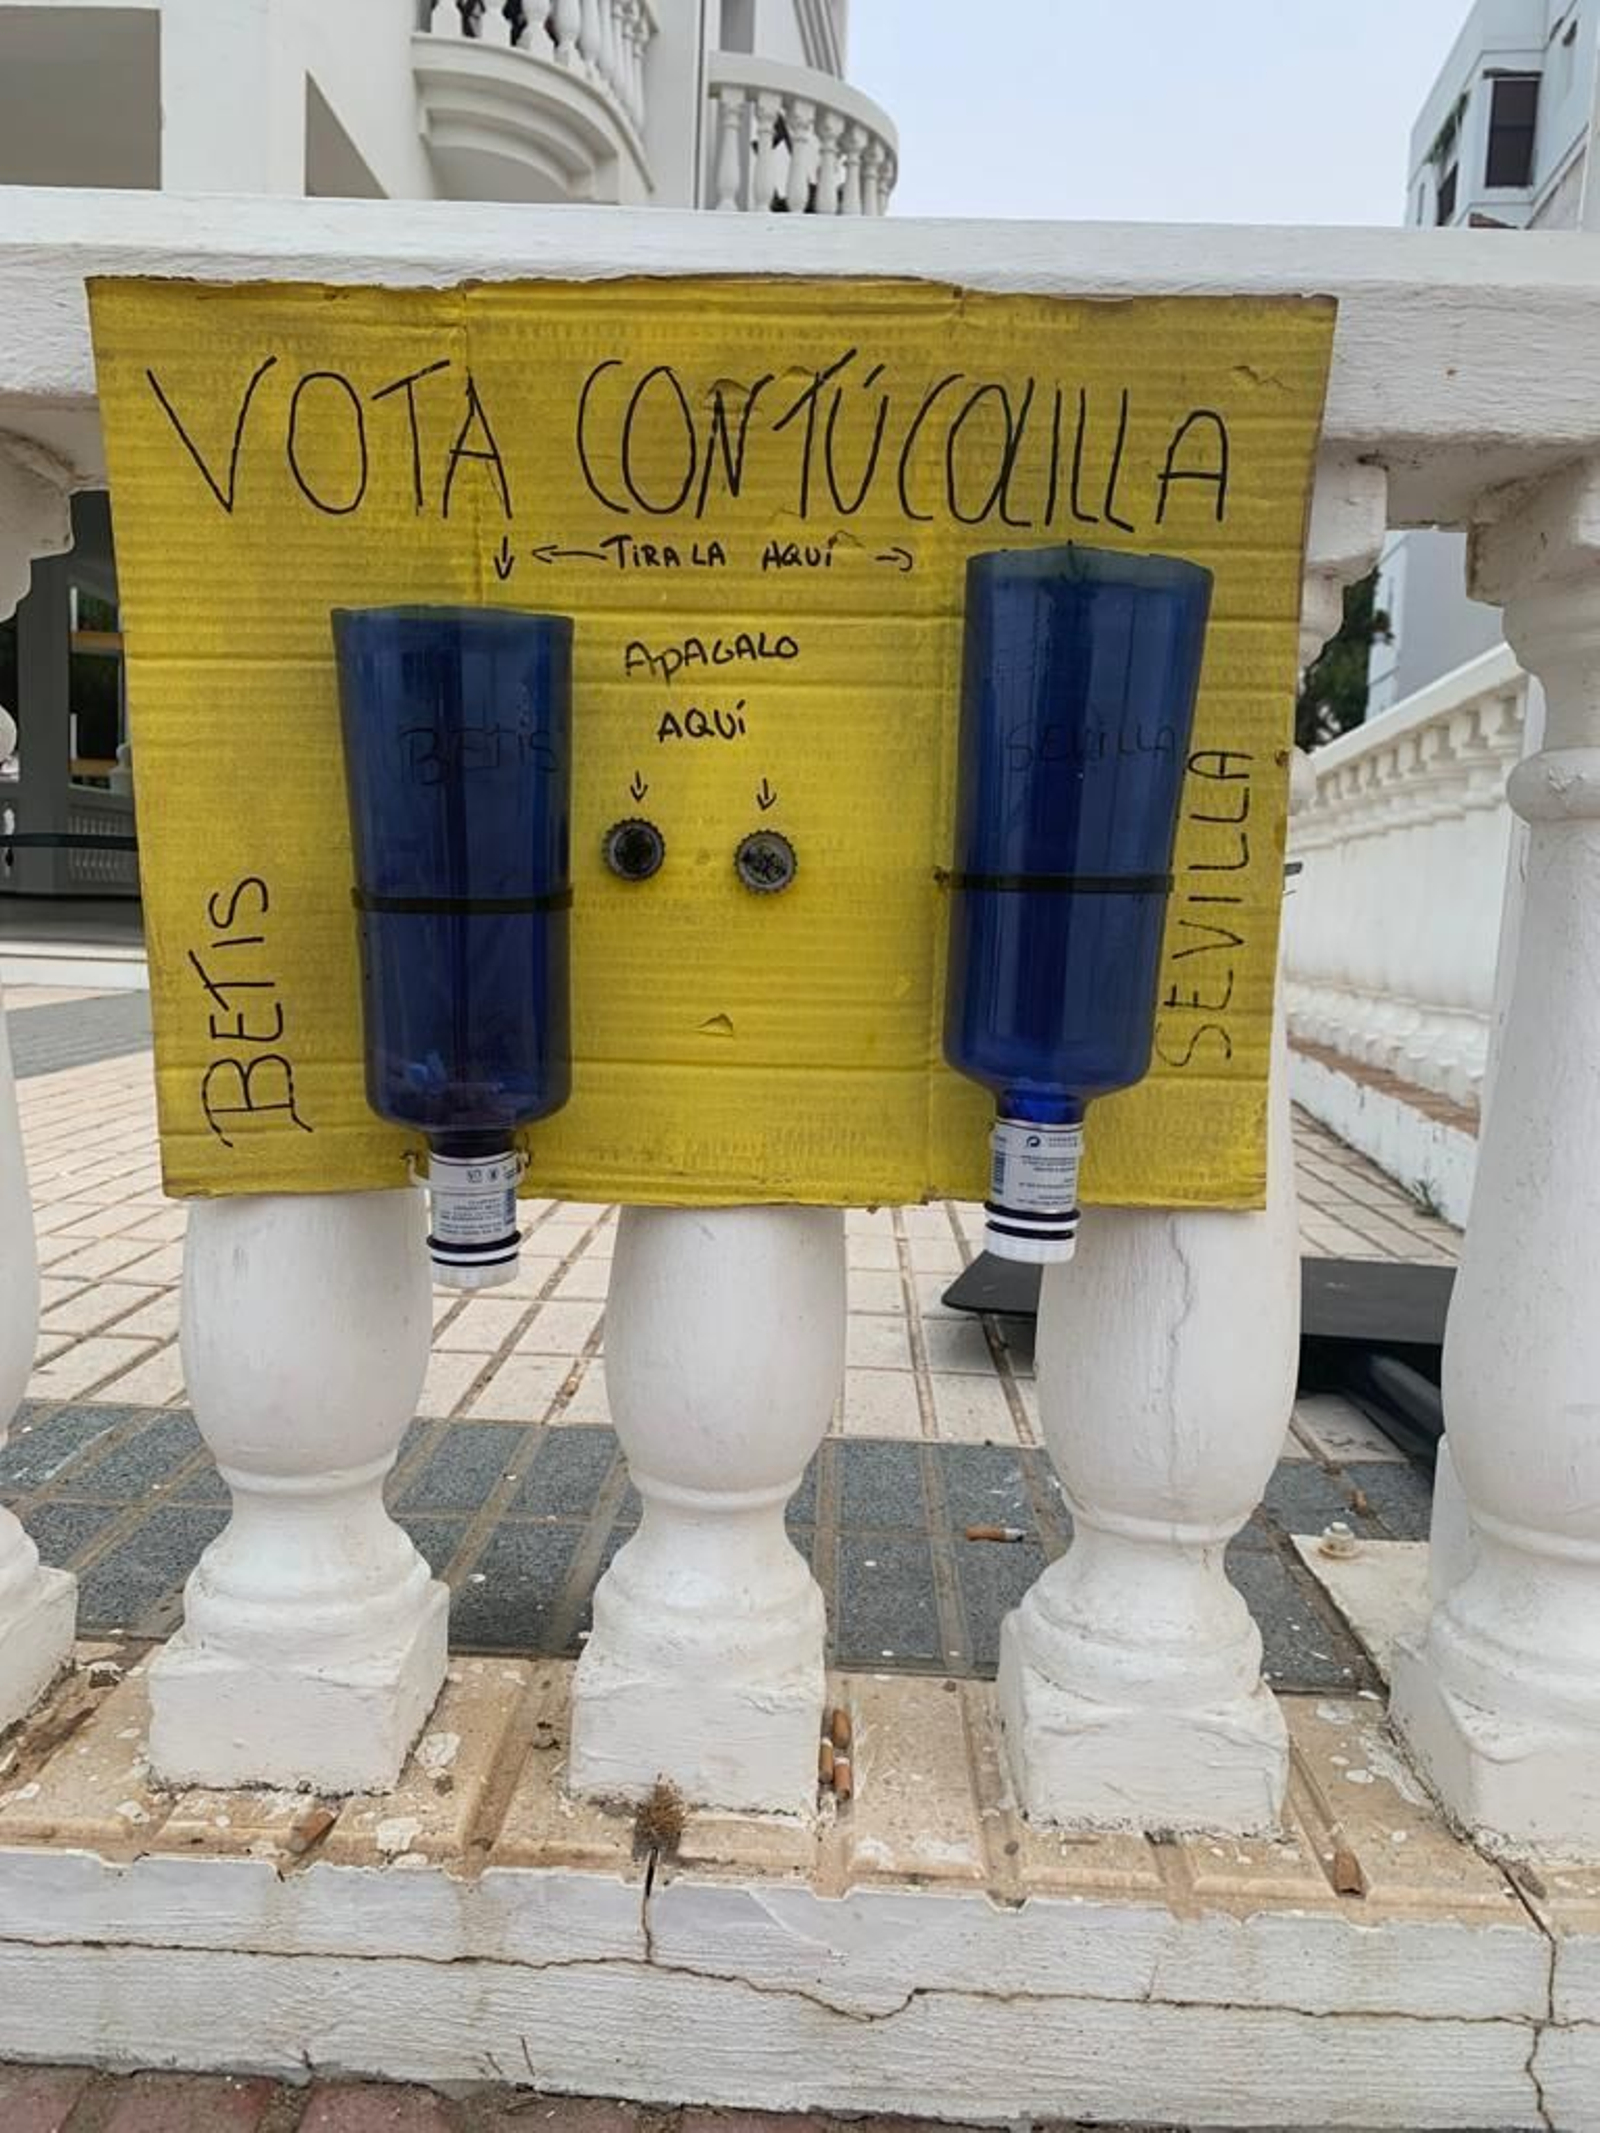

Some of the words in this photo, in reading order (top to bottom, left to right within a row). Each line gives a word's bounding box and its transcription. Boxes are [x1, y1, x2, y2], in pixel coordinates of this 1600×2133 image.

[146, 355, 513, 519] VOTA
[188, 877, 314, 1148] BETIS
[1154, 751, 1254, 1068] SEVILLA
